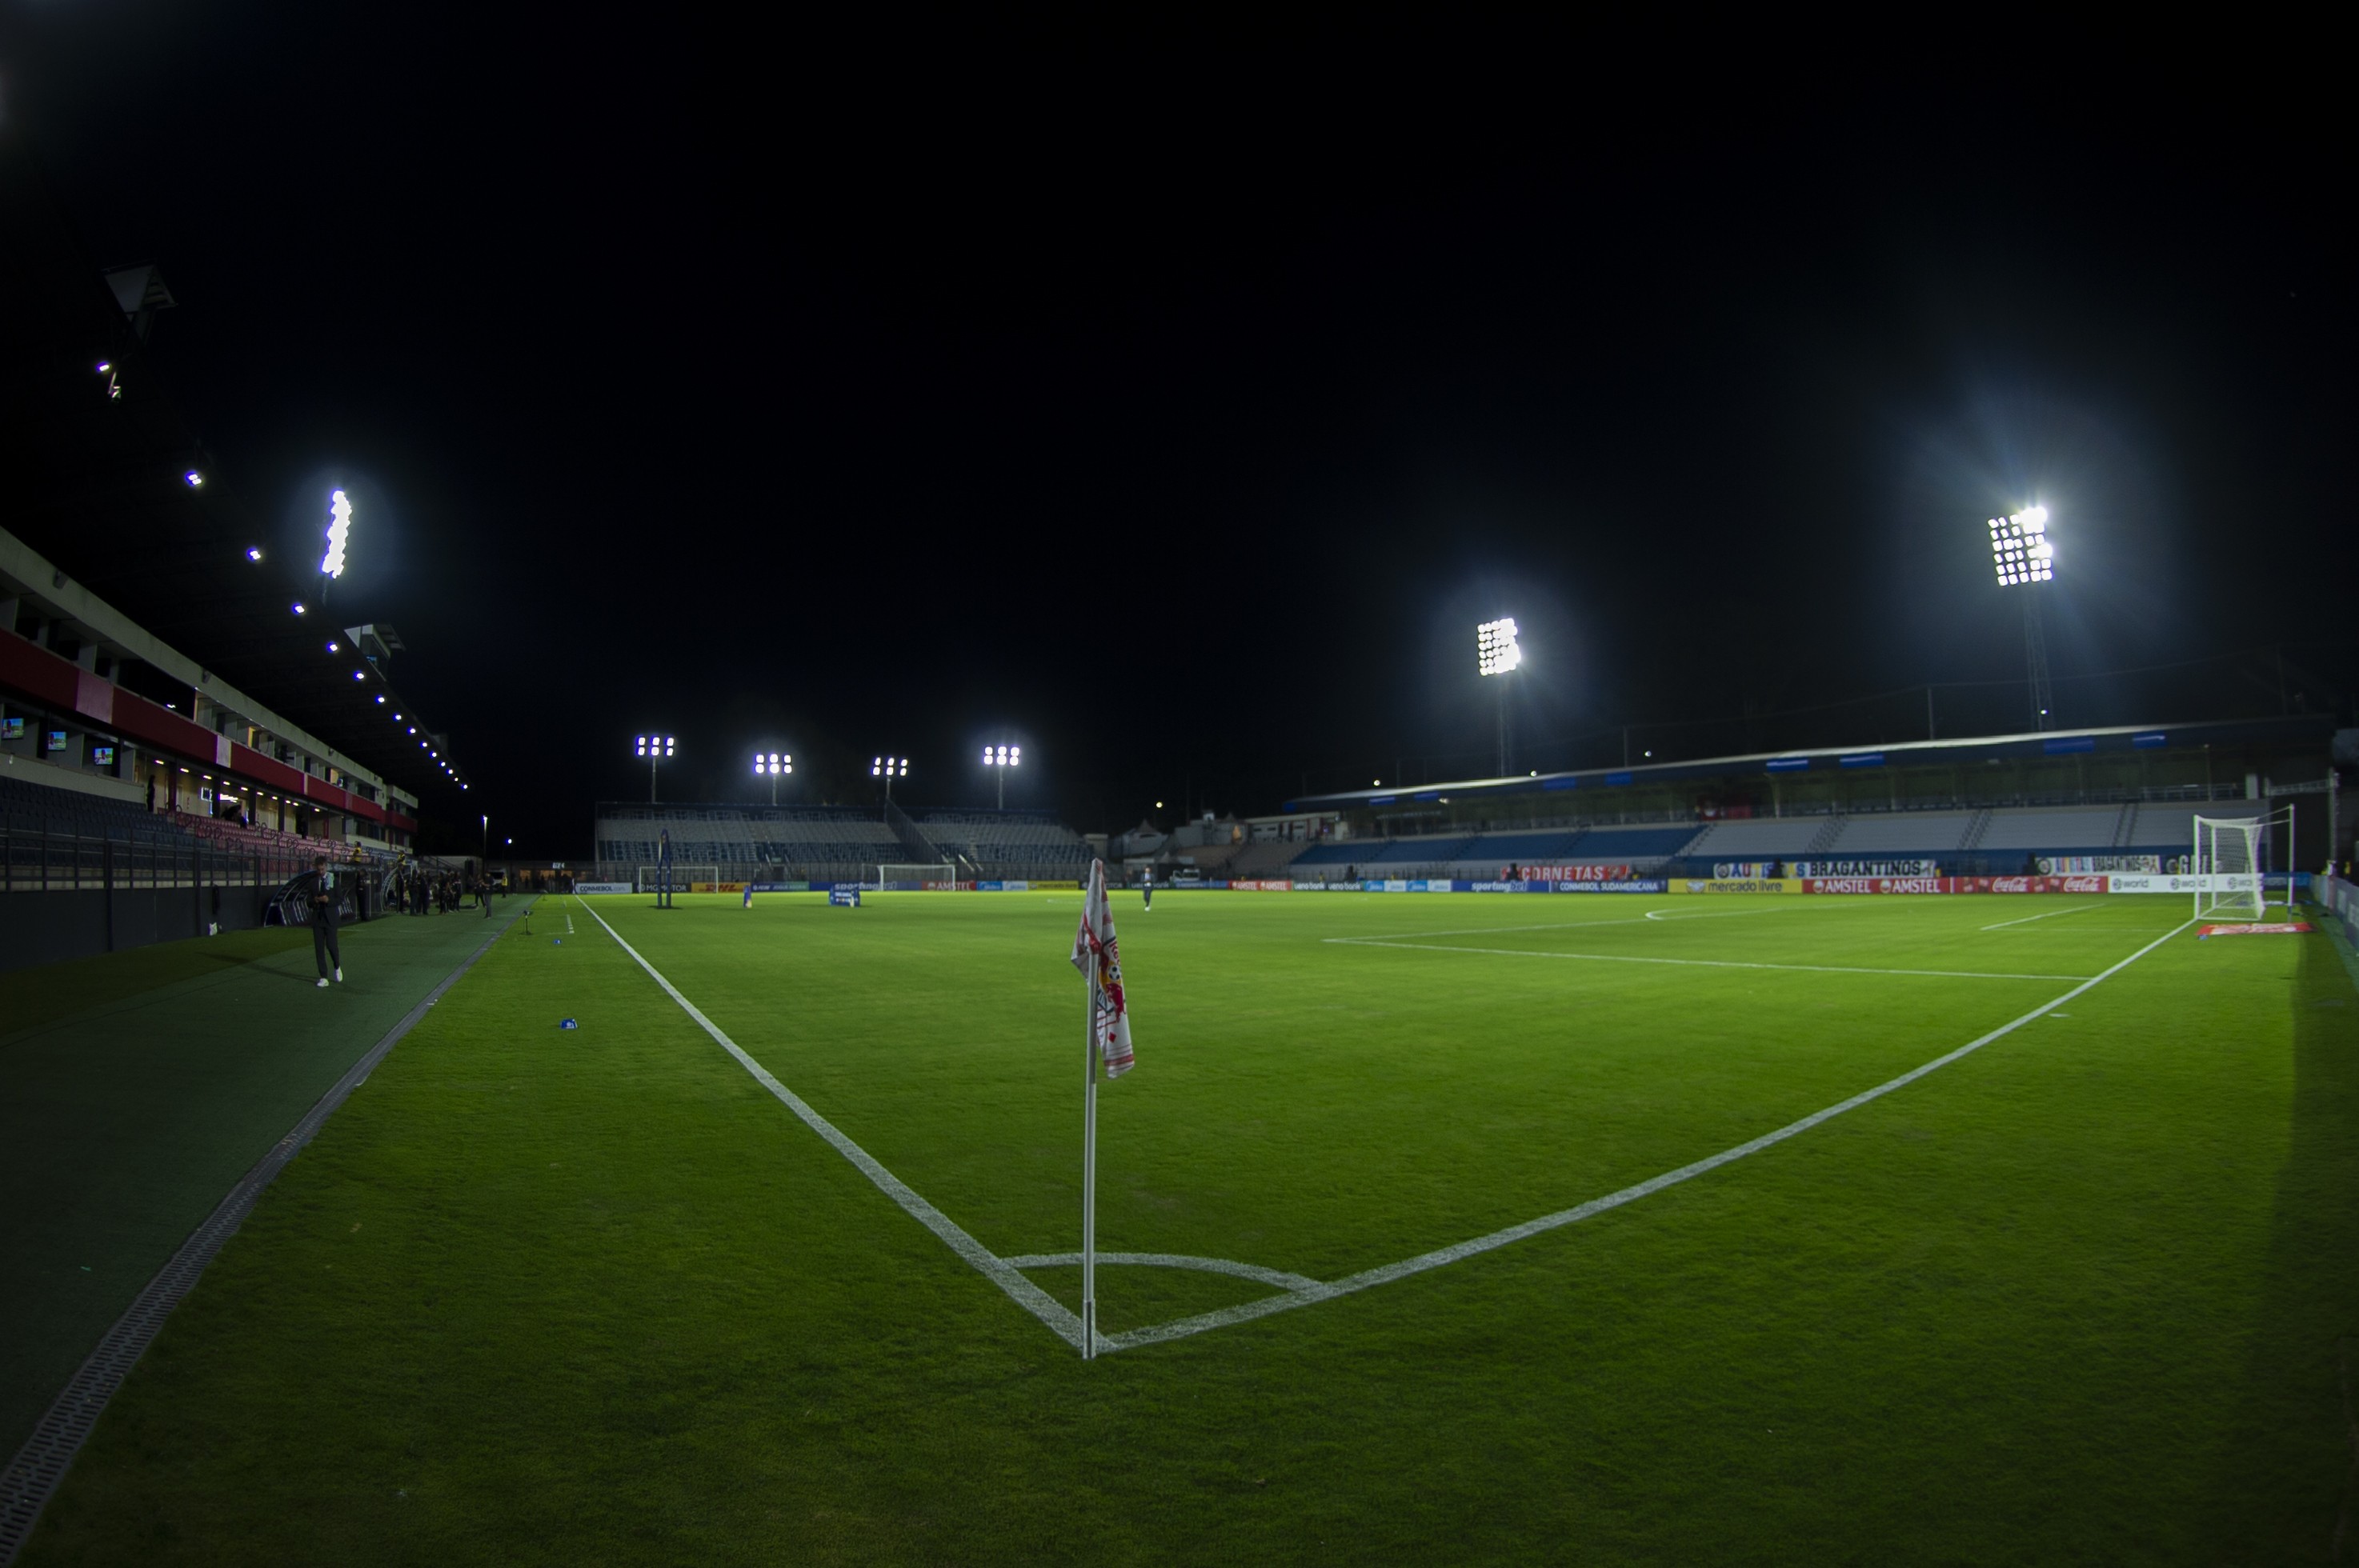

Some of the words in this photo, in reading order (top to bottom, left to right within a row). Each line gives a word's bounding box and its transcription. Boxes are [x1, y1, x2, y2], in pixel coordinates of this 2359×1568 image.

[1521, 866, 1604, 881] CORNETAS
[1809, 861, 1921, 877] BRAGANTINOS
[1471, 881, 1528, 892] sportingbet
[1560, 882, 1600, 890] CONMEBOL
[1600, 881, 1659, 892] SUDAMERICANA
[1708, 881, 1756, 892] mercado
[1759, 881, 1783, 892] livre
[1824, 879, 1871, 893] AMSTEL
[1892, 879, 1941, 893] AMSTEL
[1992, 877, 2029, 893] Coca-Cola
[2063, 877, 2101, 893] Coca-Cola
